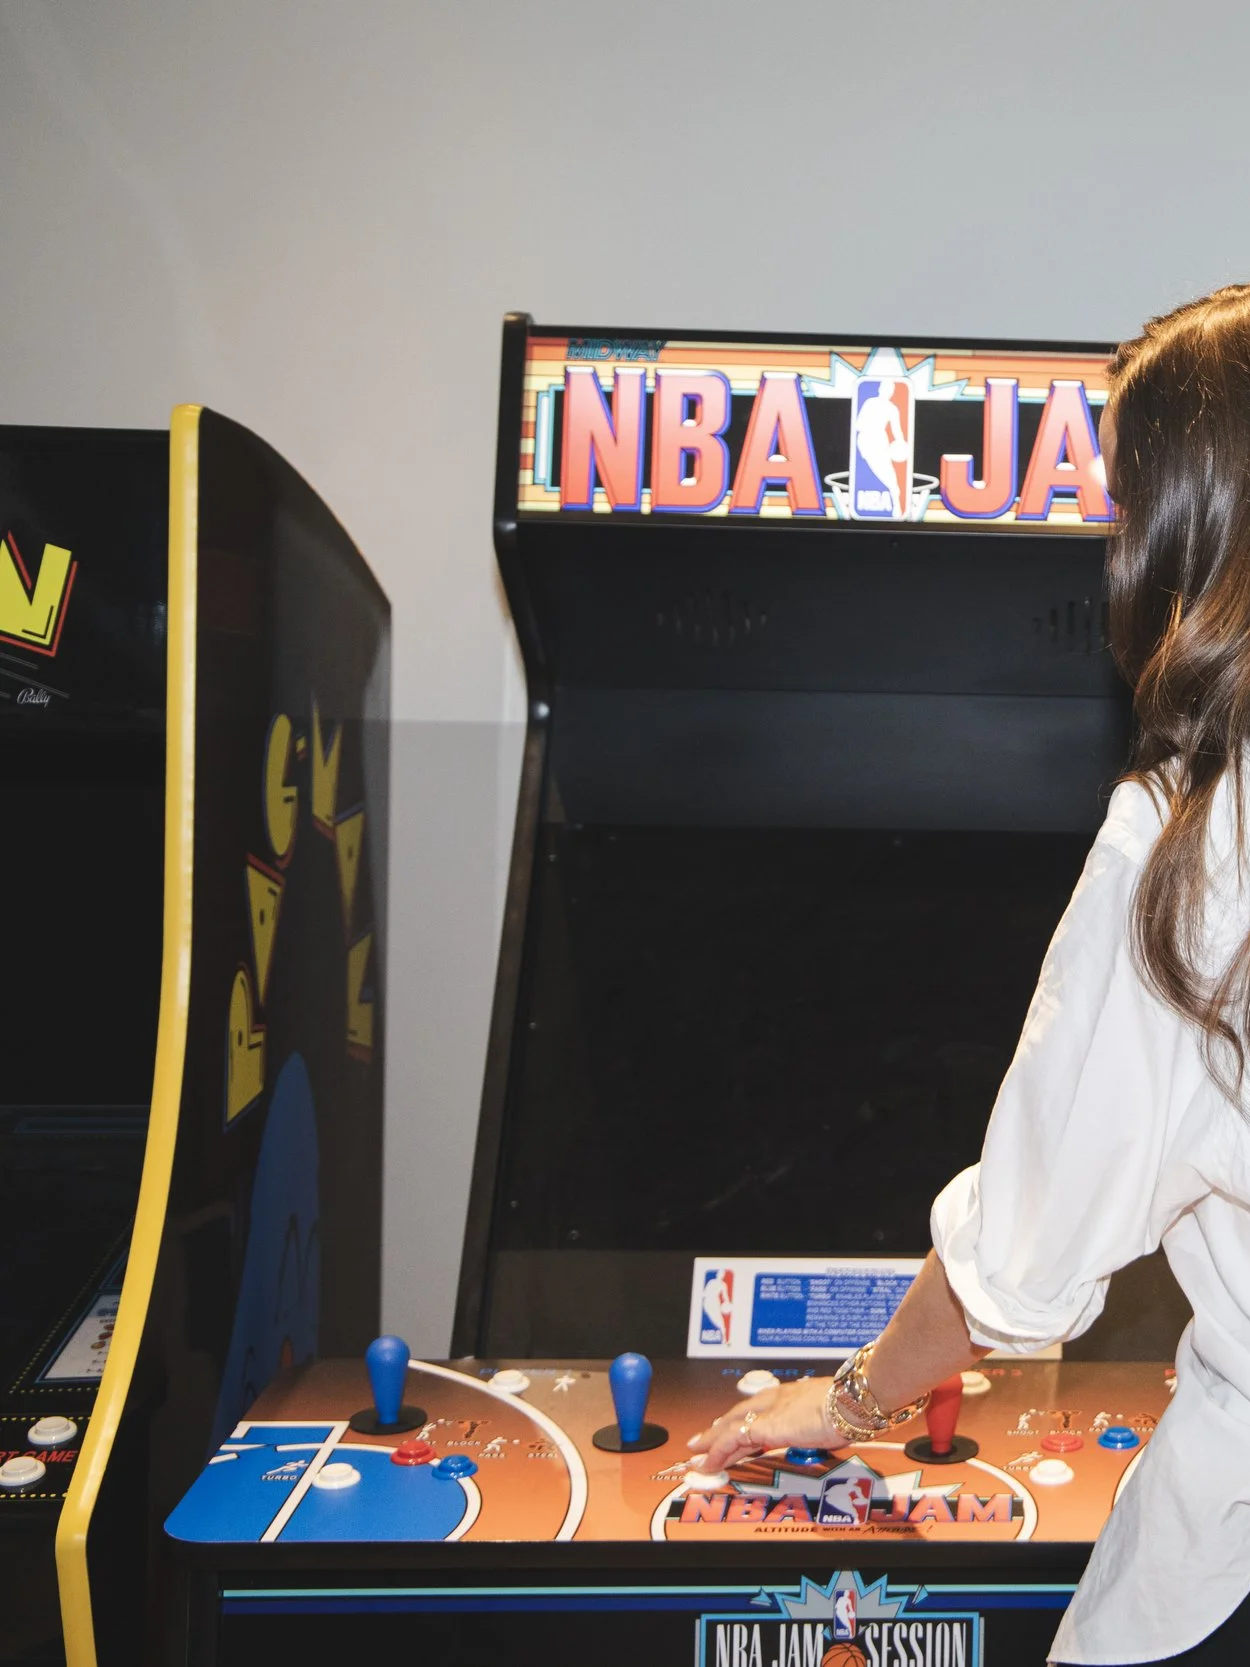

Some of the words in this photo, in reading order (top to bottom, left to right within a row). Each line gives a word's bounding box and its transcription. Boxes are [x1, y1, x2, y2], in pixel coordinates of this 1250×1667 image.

[566, 338, 668, 361] MIDWAY
[558, 366, 826, 517] NBA
[940, 376, 1117, 523] JA
[16, 687, 51, 708] Bally
[259, 1473, 299, 1481] TURBO
[679, 1494, 813, 1524] NBA
[869, 1493, 1014, 1524] JAM
[822, 1514, 852, 1523] NBA
[715, 1623, 763, 1667] NBA
[772, 1622, 825, 1667] JAM
[864, 1621, 968, 1667] SESSION
